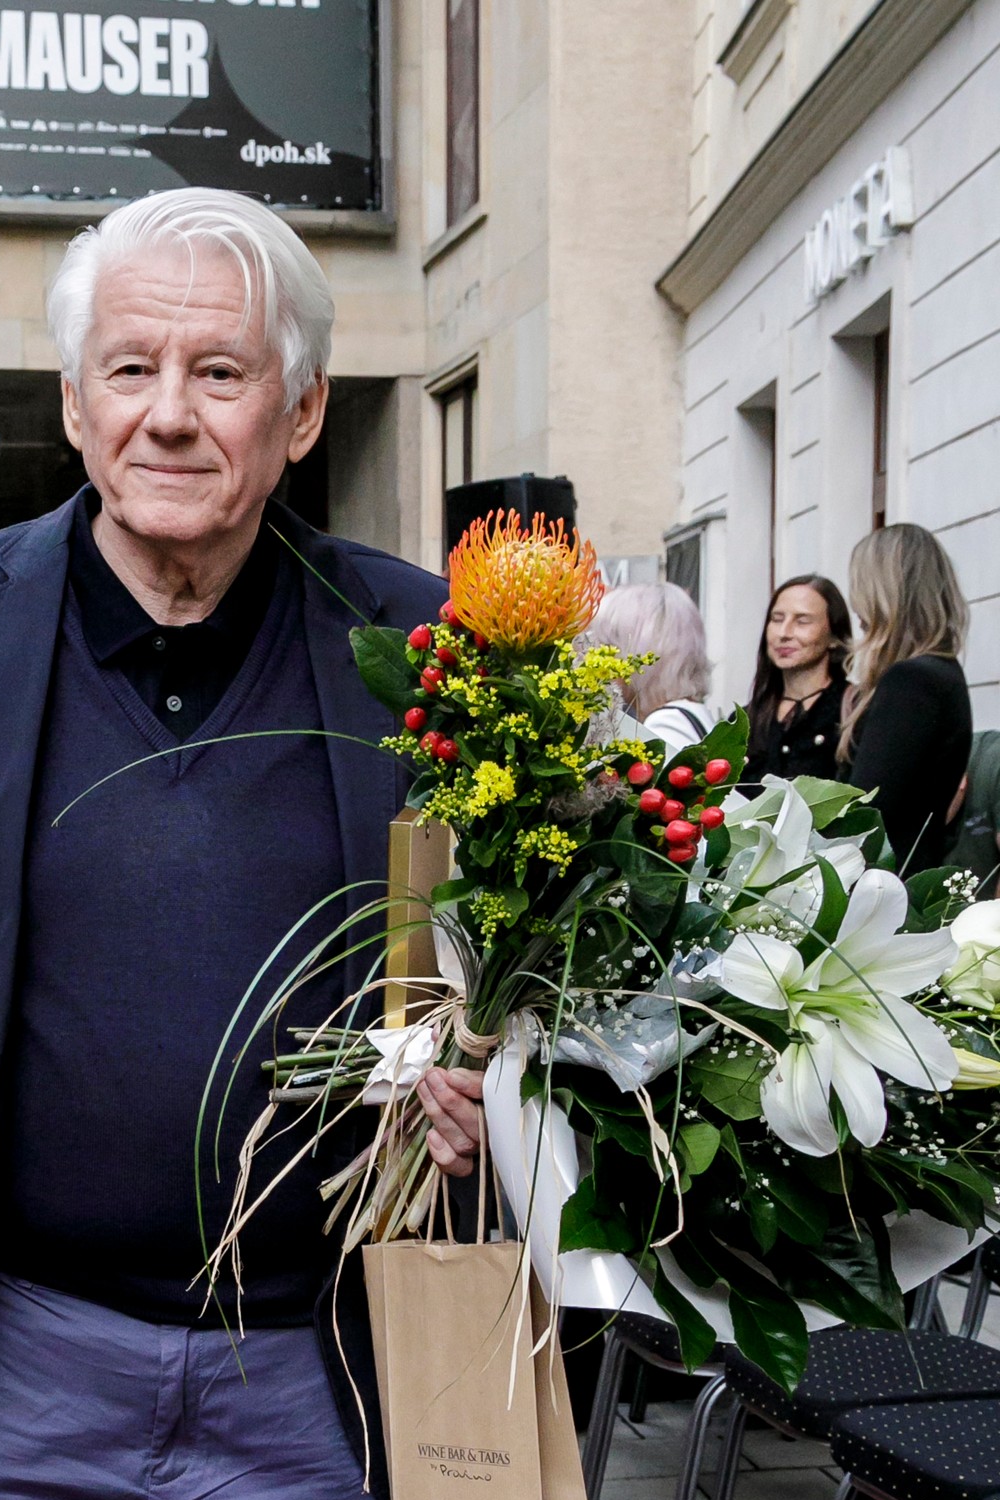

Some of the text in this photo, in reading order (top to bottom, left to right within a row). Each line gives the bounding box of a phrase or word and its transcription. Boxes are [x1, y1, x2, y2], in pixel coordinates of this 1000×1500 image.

[240, 139, 332, 167] dpoh.sk
[805, 146, 914, 304] MONETA
[417, 1444, 511, 1465] WINE BAR & TAPAS
